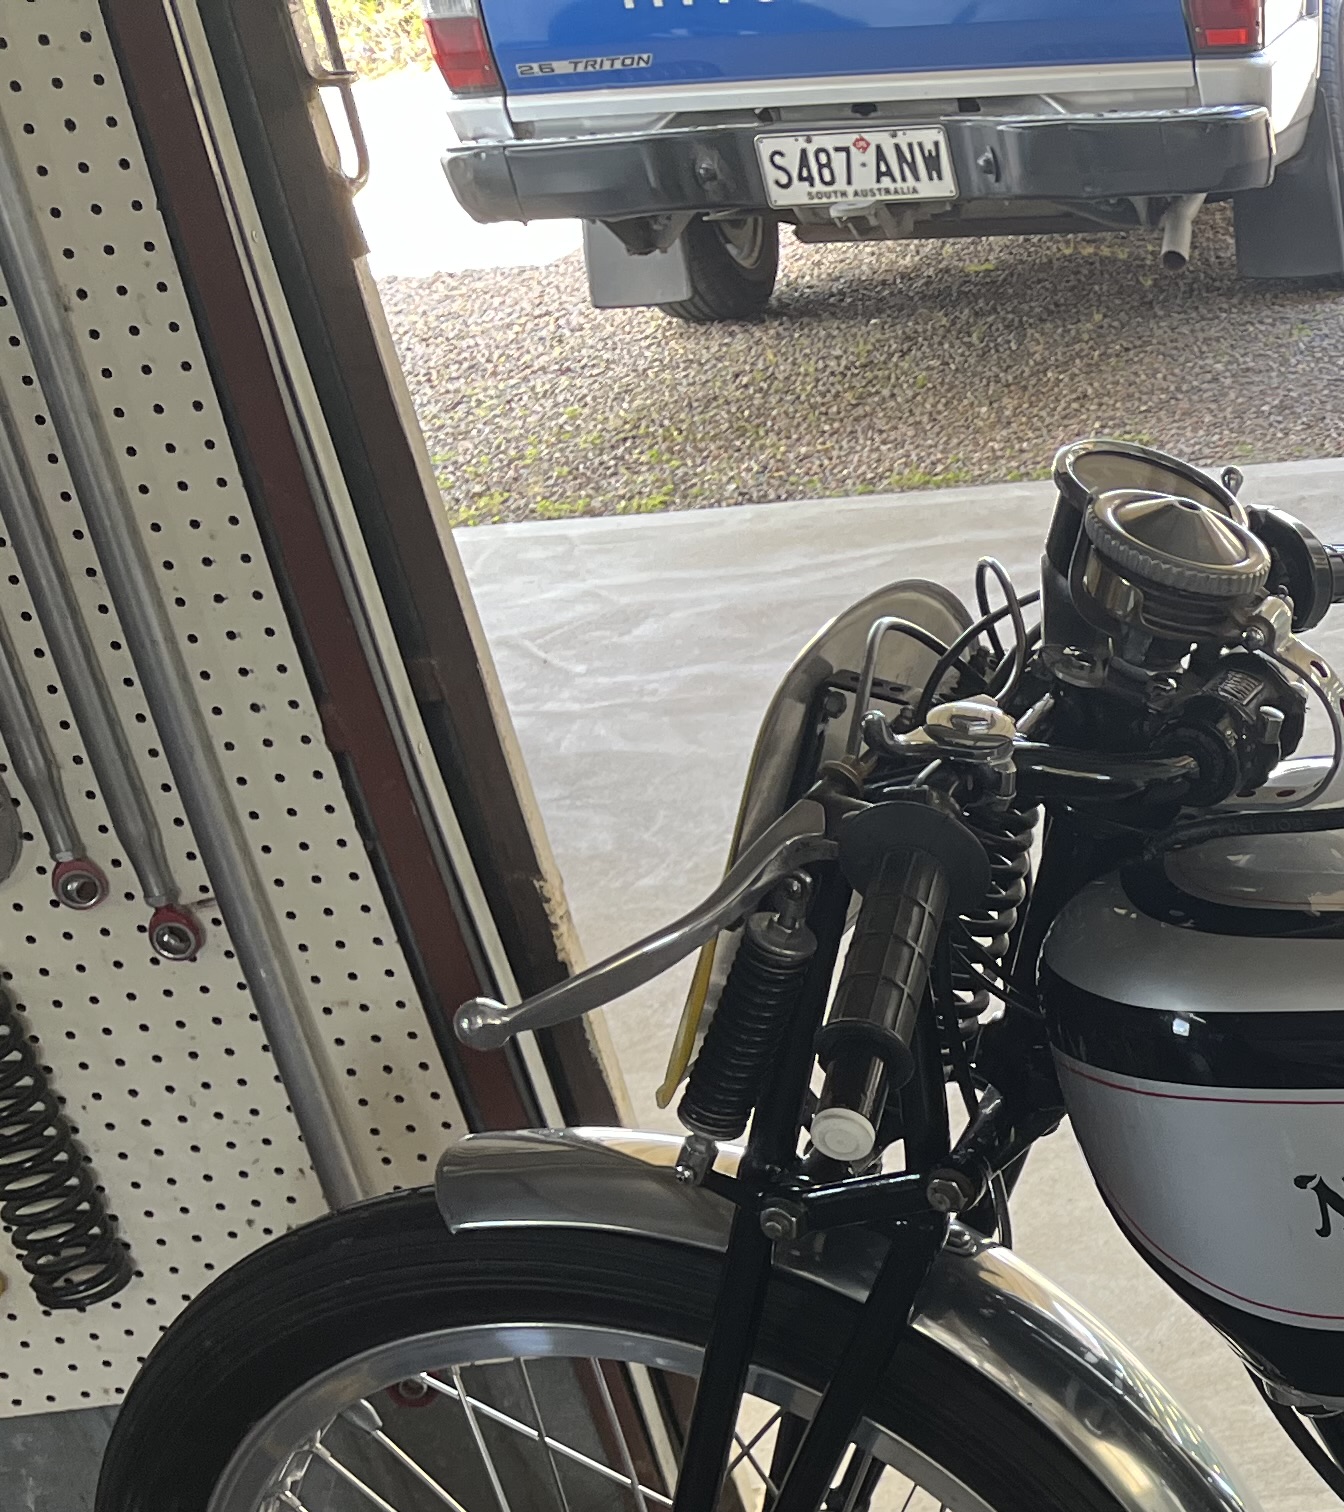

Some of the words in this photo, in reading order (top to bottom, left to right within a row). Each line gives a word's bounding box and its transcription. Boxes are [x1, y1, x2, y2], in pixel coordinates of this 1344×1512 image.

[568, 54, 652, 72] TRITON
[769, 146, 854, 190] S487
[875, 140, 943, 184] ANW
[806, 189, 849, 201] SOUTH
[852, 186, 919, 198] AUSTRALIA
